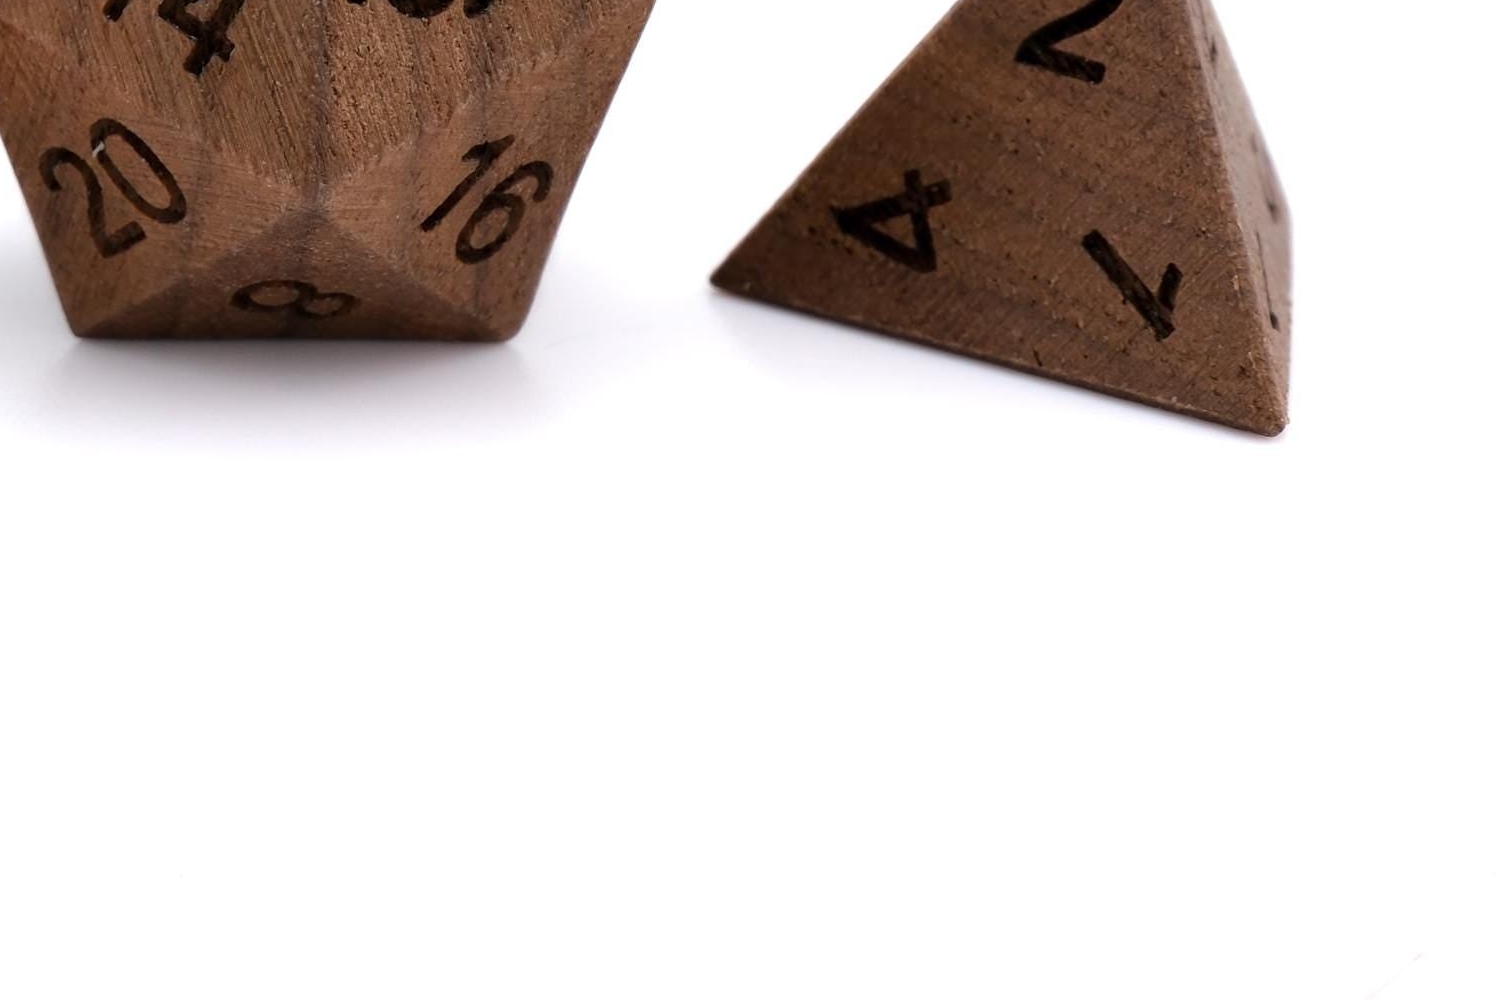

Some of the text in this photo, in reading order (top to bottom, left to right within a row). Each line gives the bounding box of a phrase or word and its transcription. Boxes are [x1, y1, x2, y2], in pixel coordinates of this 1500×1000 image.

[38, 116, 188, 259] 20
[420, 135, 555, 266] 16
[831, 169, 952, 274] 4
[230, 278, 357, 319] 8
[1080, 229, 1184, 341] 1
